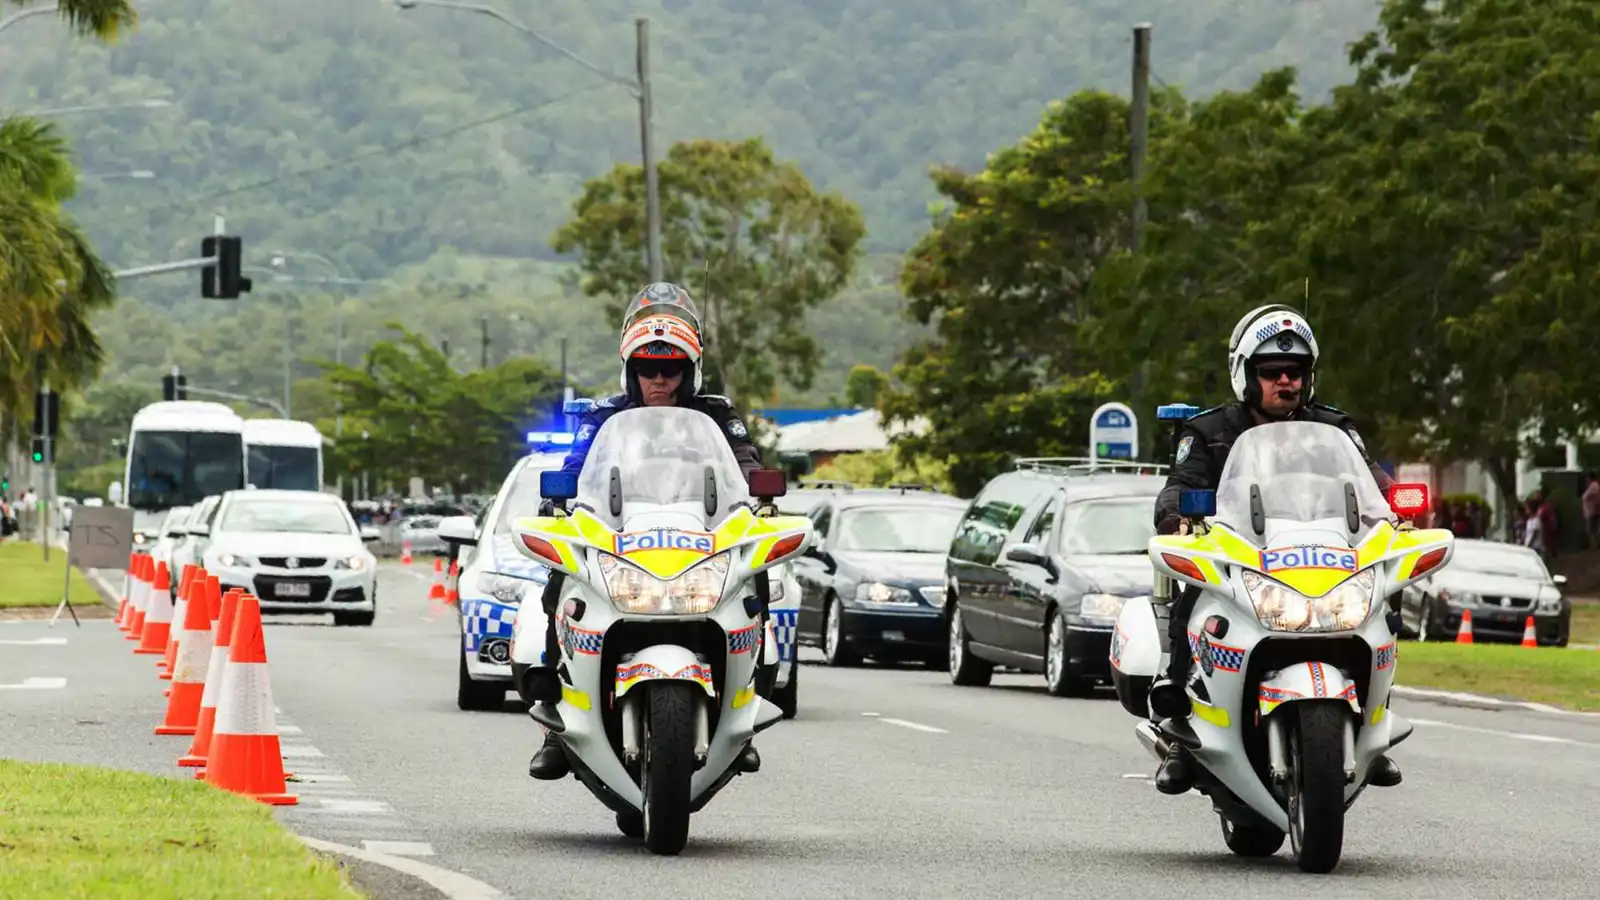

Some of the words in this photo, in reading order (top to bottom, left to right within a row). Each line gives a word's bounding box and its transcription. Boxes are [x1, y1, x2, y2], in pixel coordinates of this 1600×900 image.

[76, 524, 119, 547] TS
[617, 528, 711, 553] Police
[1262, 547, 1356, 570] Police
